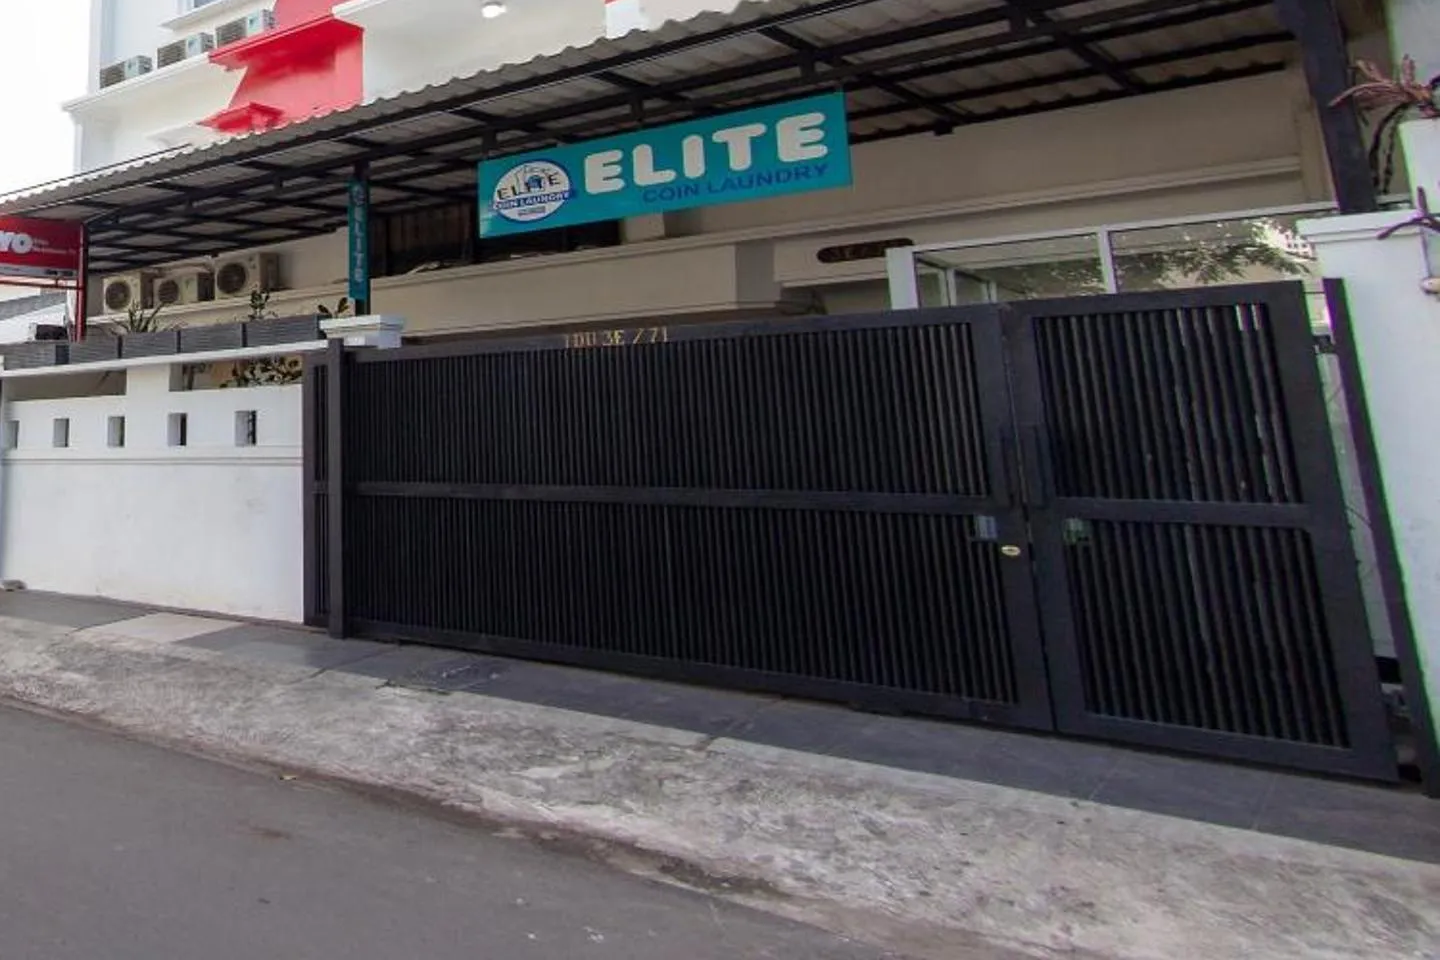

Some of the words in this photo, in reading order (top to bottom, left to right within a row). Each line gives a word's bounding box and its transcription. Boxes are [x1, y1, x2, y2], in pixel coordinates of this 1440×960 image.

[584, 112, 829, 195] ELITE
[642, 183, 700, 204] COIN
[710, 163, 829, 194] LAUNDRY
